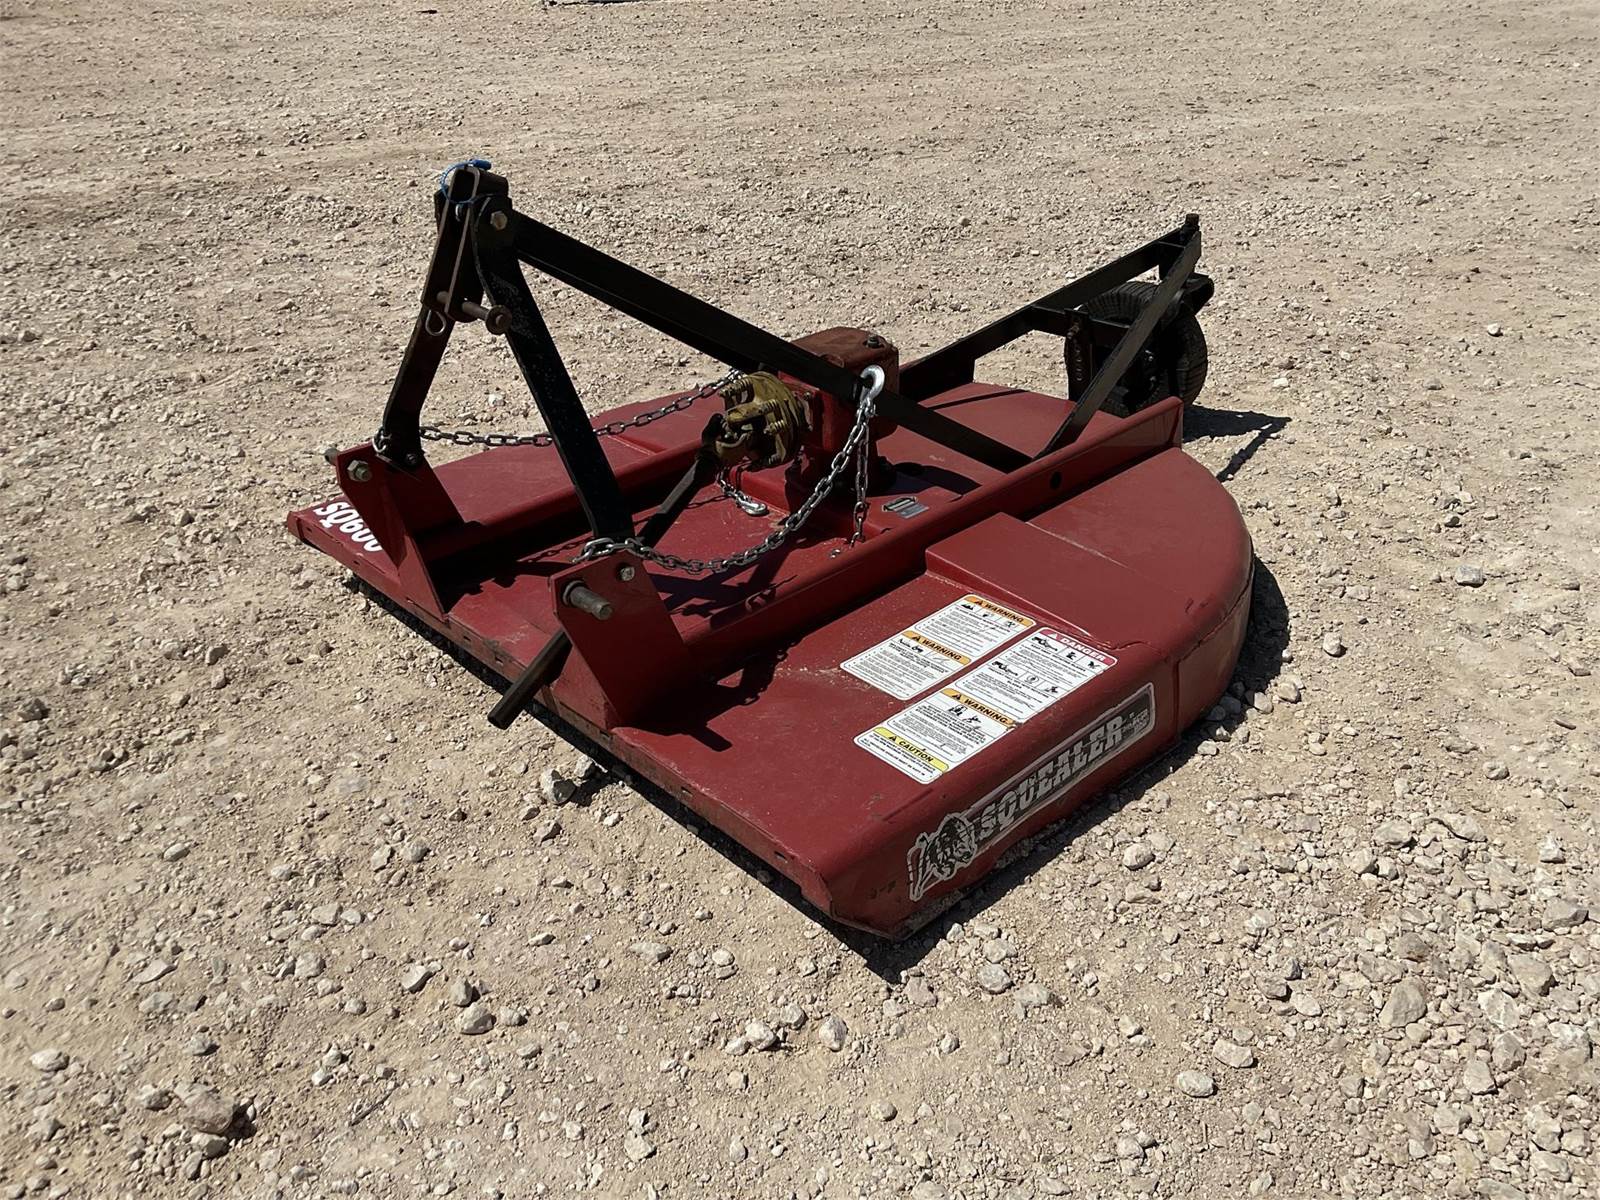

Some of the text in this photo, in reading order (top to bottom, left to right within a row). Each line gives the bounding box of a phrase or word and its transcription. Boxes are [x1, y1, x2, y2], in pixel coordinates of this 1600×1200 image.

[983, 602, 1024, 623] WARNING
[922, 639, 962, 661] WARNING
[1060, 637, 1107, 662] DANGER
[964, 698, 1008, 724] WARNING
[898, 740, 934, 762] CAUTION
[979, 715, 1124, 838] SQUEALER
